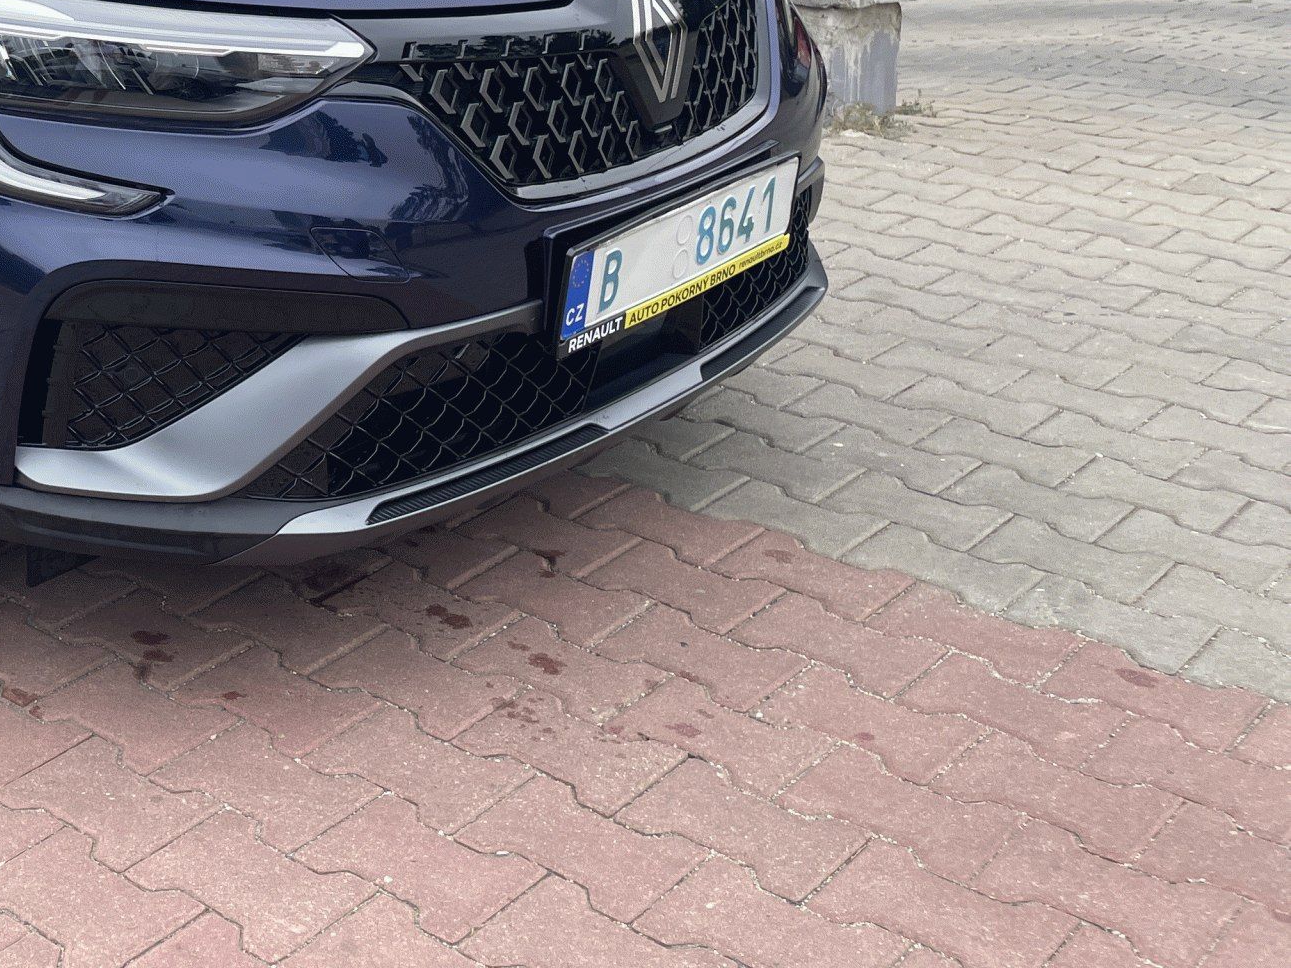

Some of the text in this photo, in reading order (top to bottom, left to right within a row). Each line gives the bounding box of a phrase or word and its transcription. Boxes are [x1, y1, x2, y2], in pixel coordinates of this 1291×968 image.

[597, 176, 776, 313] B 8641
[565, 302, 585, 327] CZ
[628, 300, 659, 326] AUTO
[661, 277, 709, 308] POKORNÝ
[710, 264, 736, 286] BRNO
[568, 316, 623, 354] RENAULT
